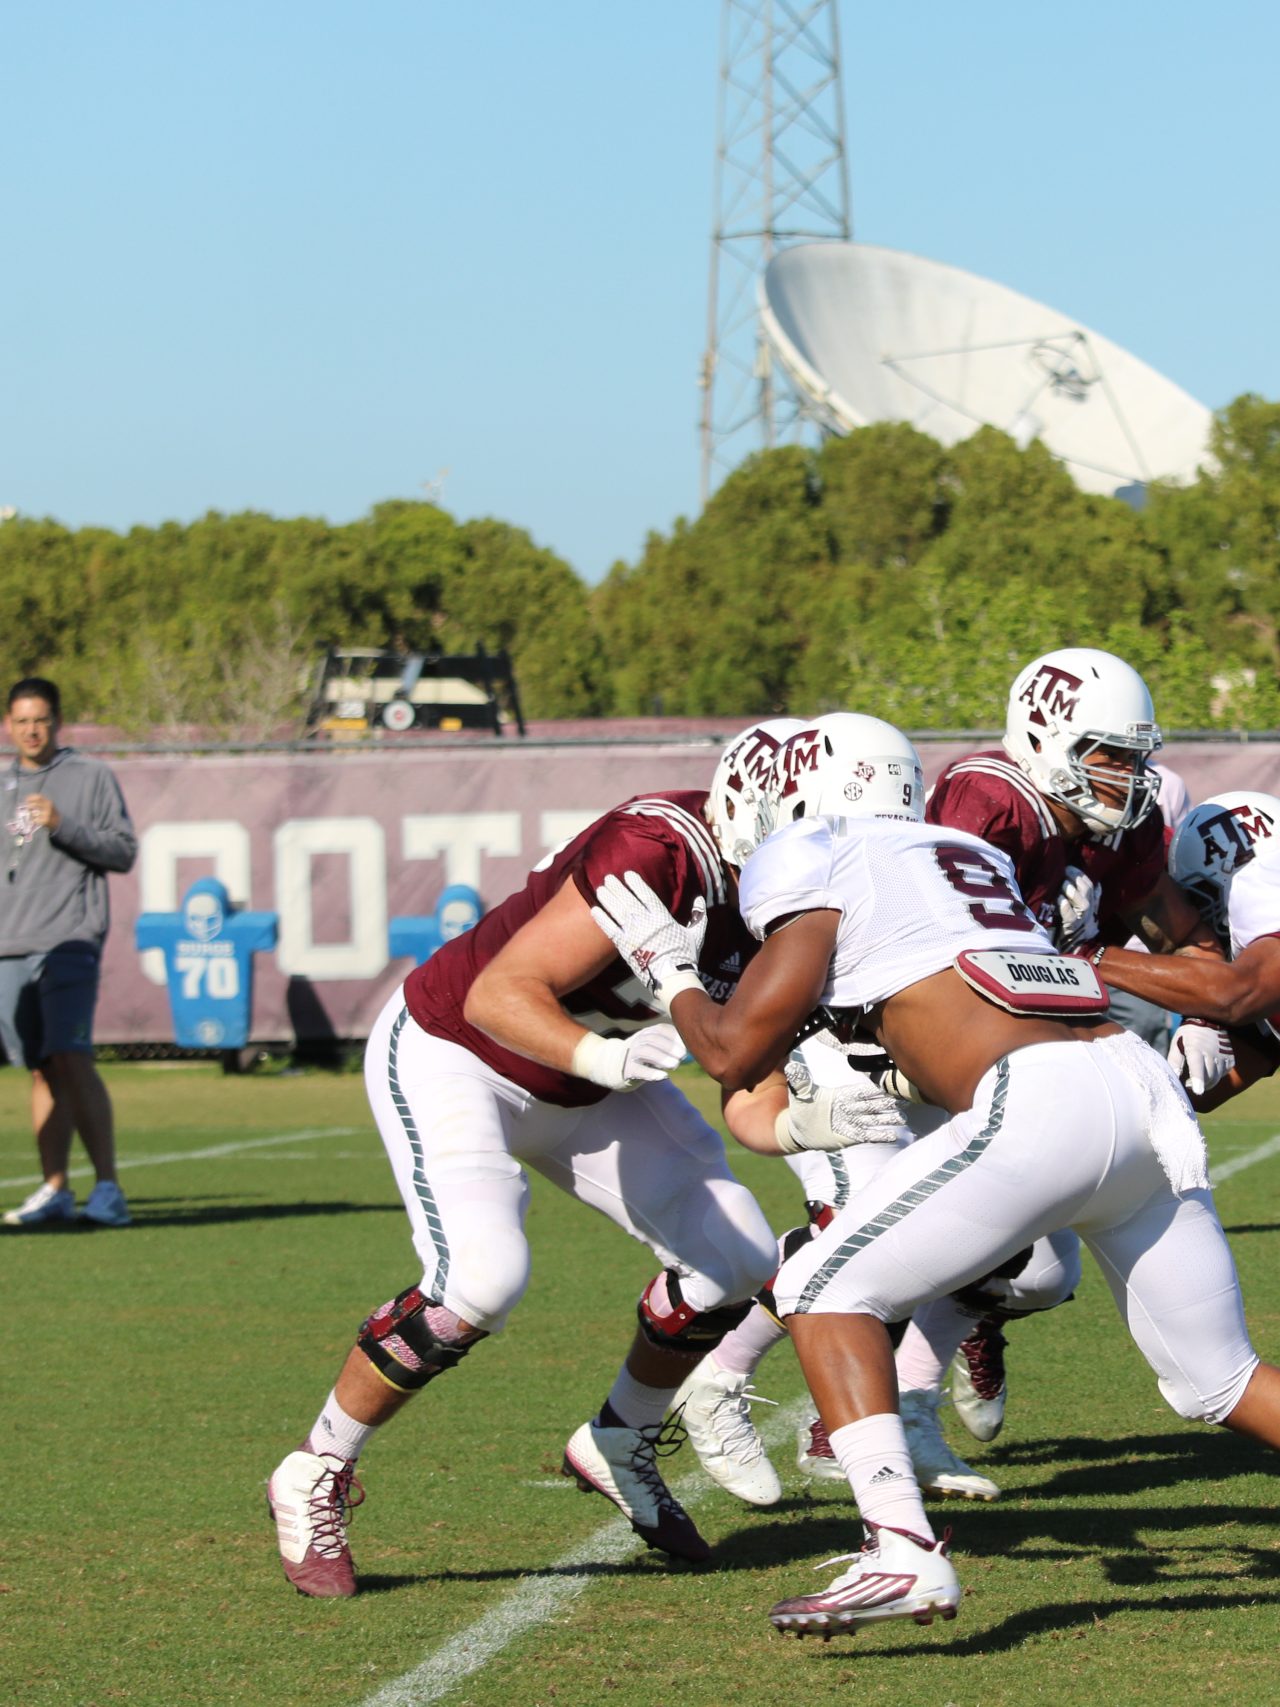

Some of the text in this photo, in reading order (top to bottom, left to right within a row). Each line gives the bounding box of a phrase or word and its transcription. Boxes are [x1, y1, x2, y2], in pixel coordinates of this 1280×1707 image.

[1019, 664, 1084, 728] ATM
[903, 783, 912, 806] 9
[1197, 805, 1273, 868] ATM
[935, 846, 1037, 933] 9
[175, 957, 240, 998] 70
[1006, 963, 1080, 986] DOUGLAS
